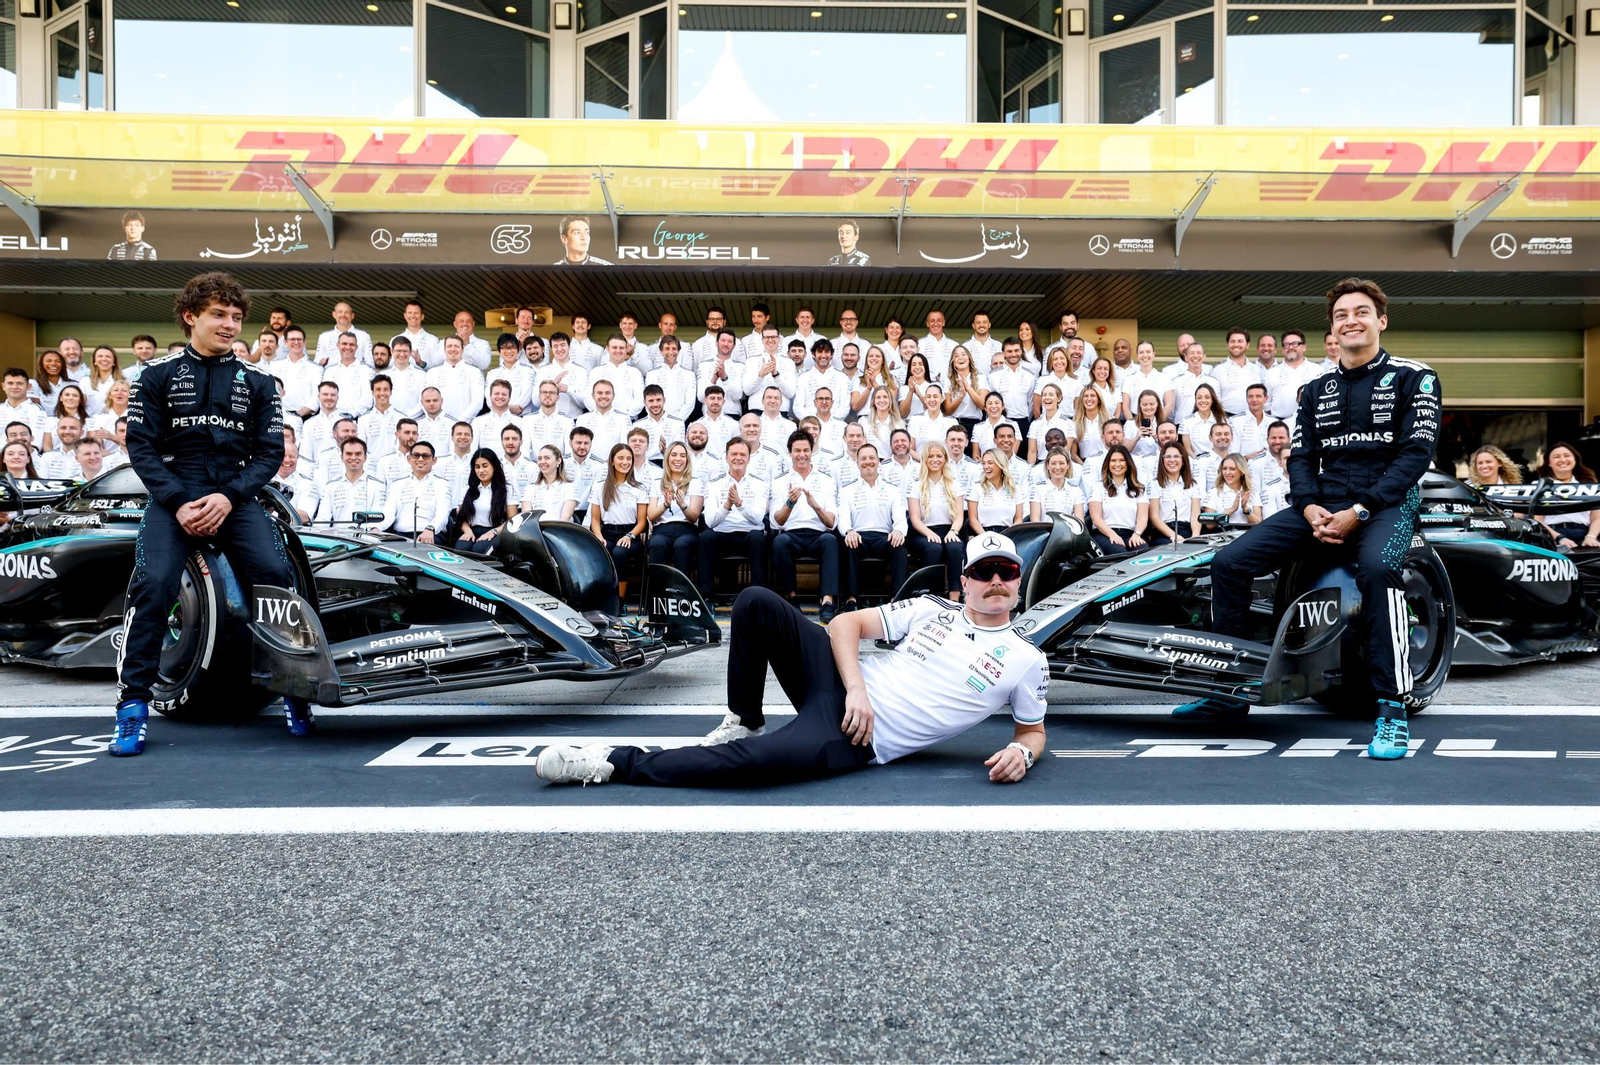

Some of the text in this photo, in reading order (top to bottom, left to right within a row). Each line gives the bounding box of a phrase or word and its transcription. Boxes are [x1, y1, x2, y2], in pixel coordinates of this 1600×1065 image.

[229, 131, 535, 194] DHL
[776, 137, 1077, 199] DHL
[1313, 141, 1600, 202] DHL
[490, 224, 532, 254] 63
[653, 220, 709, 256] George
[618, 246, 770, 260] RUSSELL
[1372, 391, 1396, 400] INEOS
[172, 414, 245, 432] PETRONAS
[1416, 409, 1435, 418] IWC
[256, 597, 301, 627] IWC
[451, 586, 497, 616] Einhell
[652, 596, 702, 618] INEOS
[1101, 588, 1145, 616] Einhell
[1297, 600, 1339, 628] IWC
[369, 629, 443, 649] PETRONAS
[931, 627, 948, 639] UBS
[1163, 632, 1234, 651] PETRONAS
[372, 647, 446, 669] Syntium
[976, 657, 1002, 679] INEOS
[984, 652, 1005, 668] PETRONAS
[1156, 646, 1229, 670] Syntium
[1125, 738, 1558, 758] DHL
